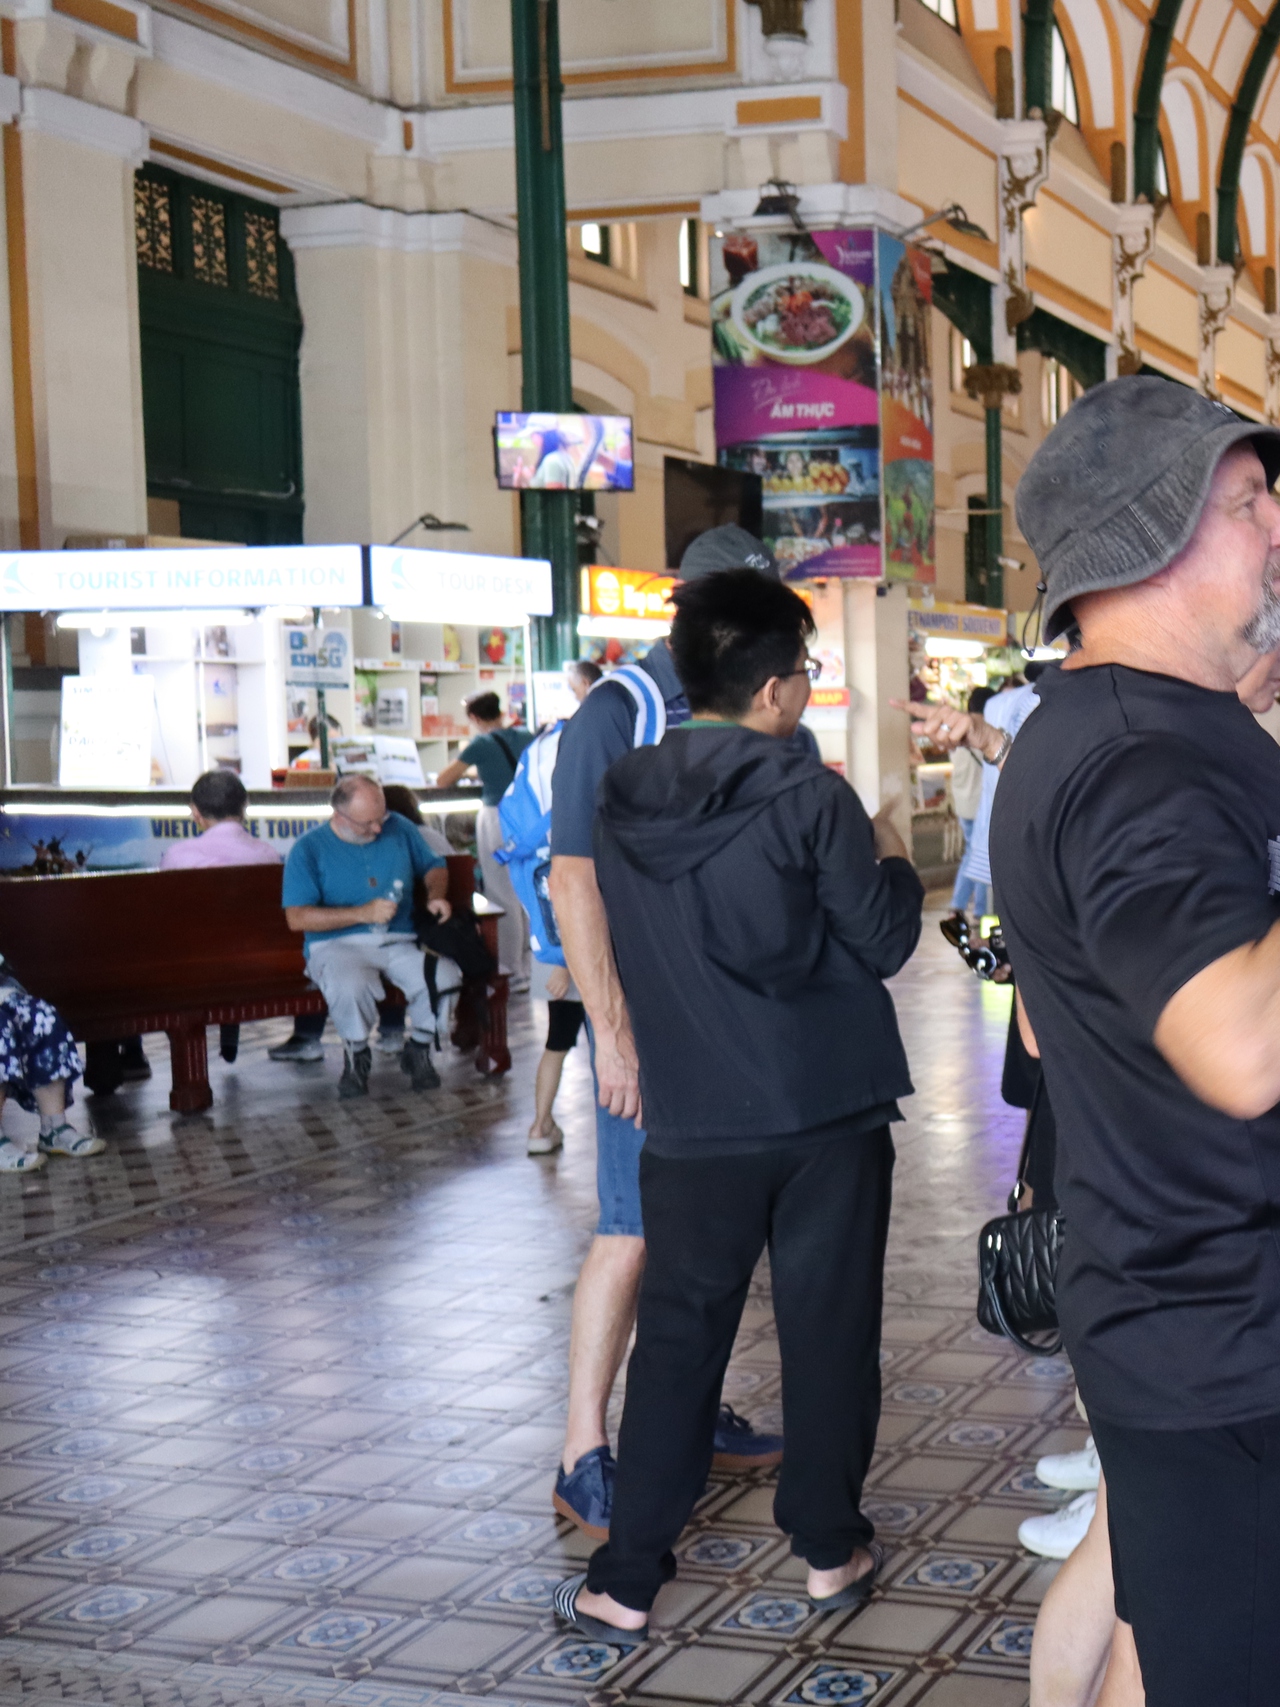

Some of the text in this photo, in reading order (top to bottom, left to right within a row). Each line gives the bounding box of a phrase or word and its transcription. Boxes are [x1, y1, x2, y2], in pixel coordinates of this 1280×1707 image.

[55, 566, 347, 590] TOURIST INFORMATION
[437, 570, 535, 596] TOUR DESK
